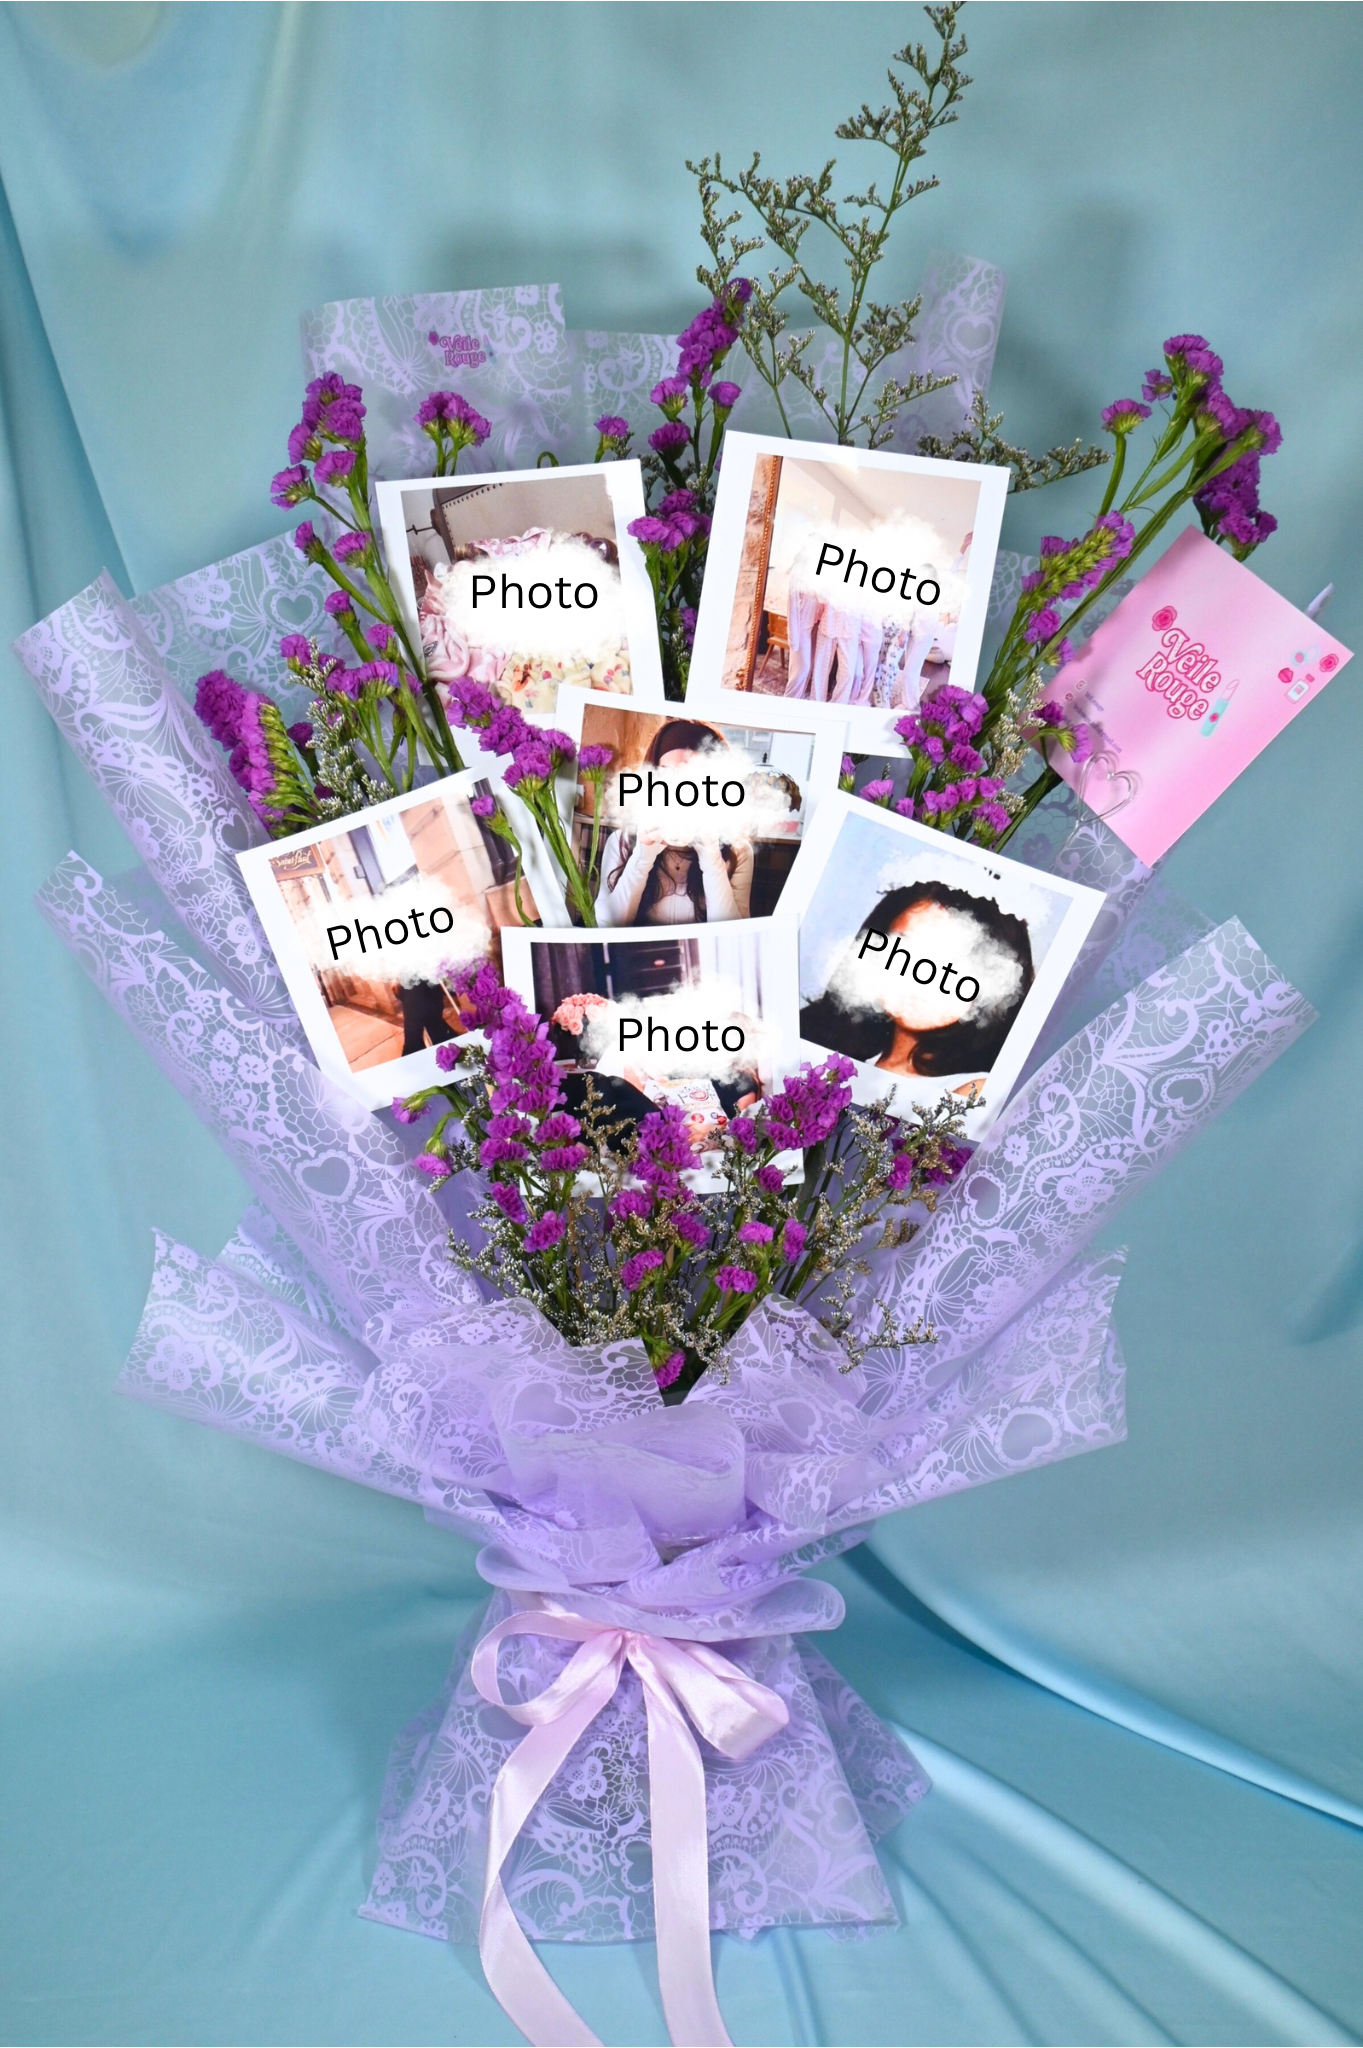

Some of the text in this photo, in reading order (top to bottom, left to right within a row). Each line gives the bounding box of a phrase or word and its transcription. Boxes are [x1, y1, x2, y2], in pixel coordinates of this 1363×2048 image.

[440, 334, 480, 352] Veile
[444, 350, 487, 369] Rouge
[1161, 627, 1222, 693] Veile
[1135, 651, 1209, 721] Rouge
